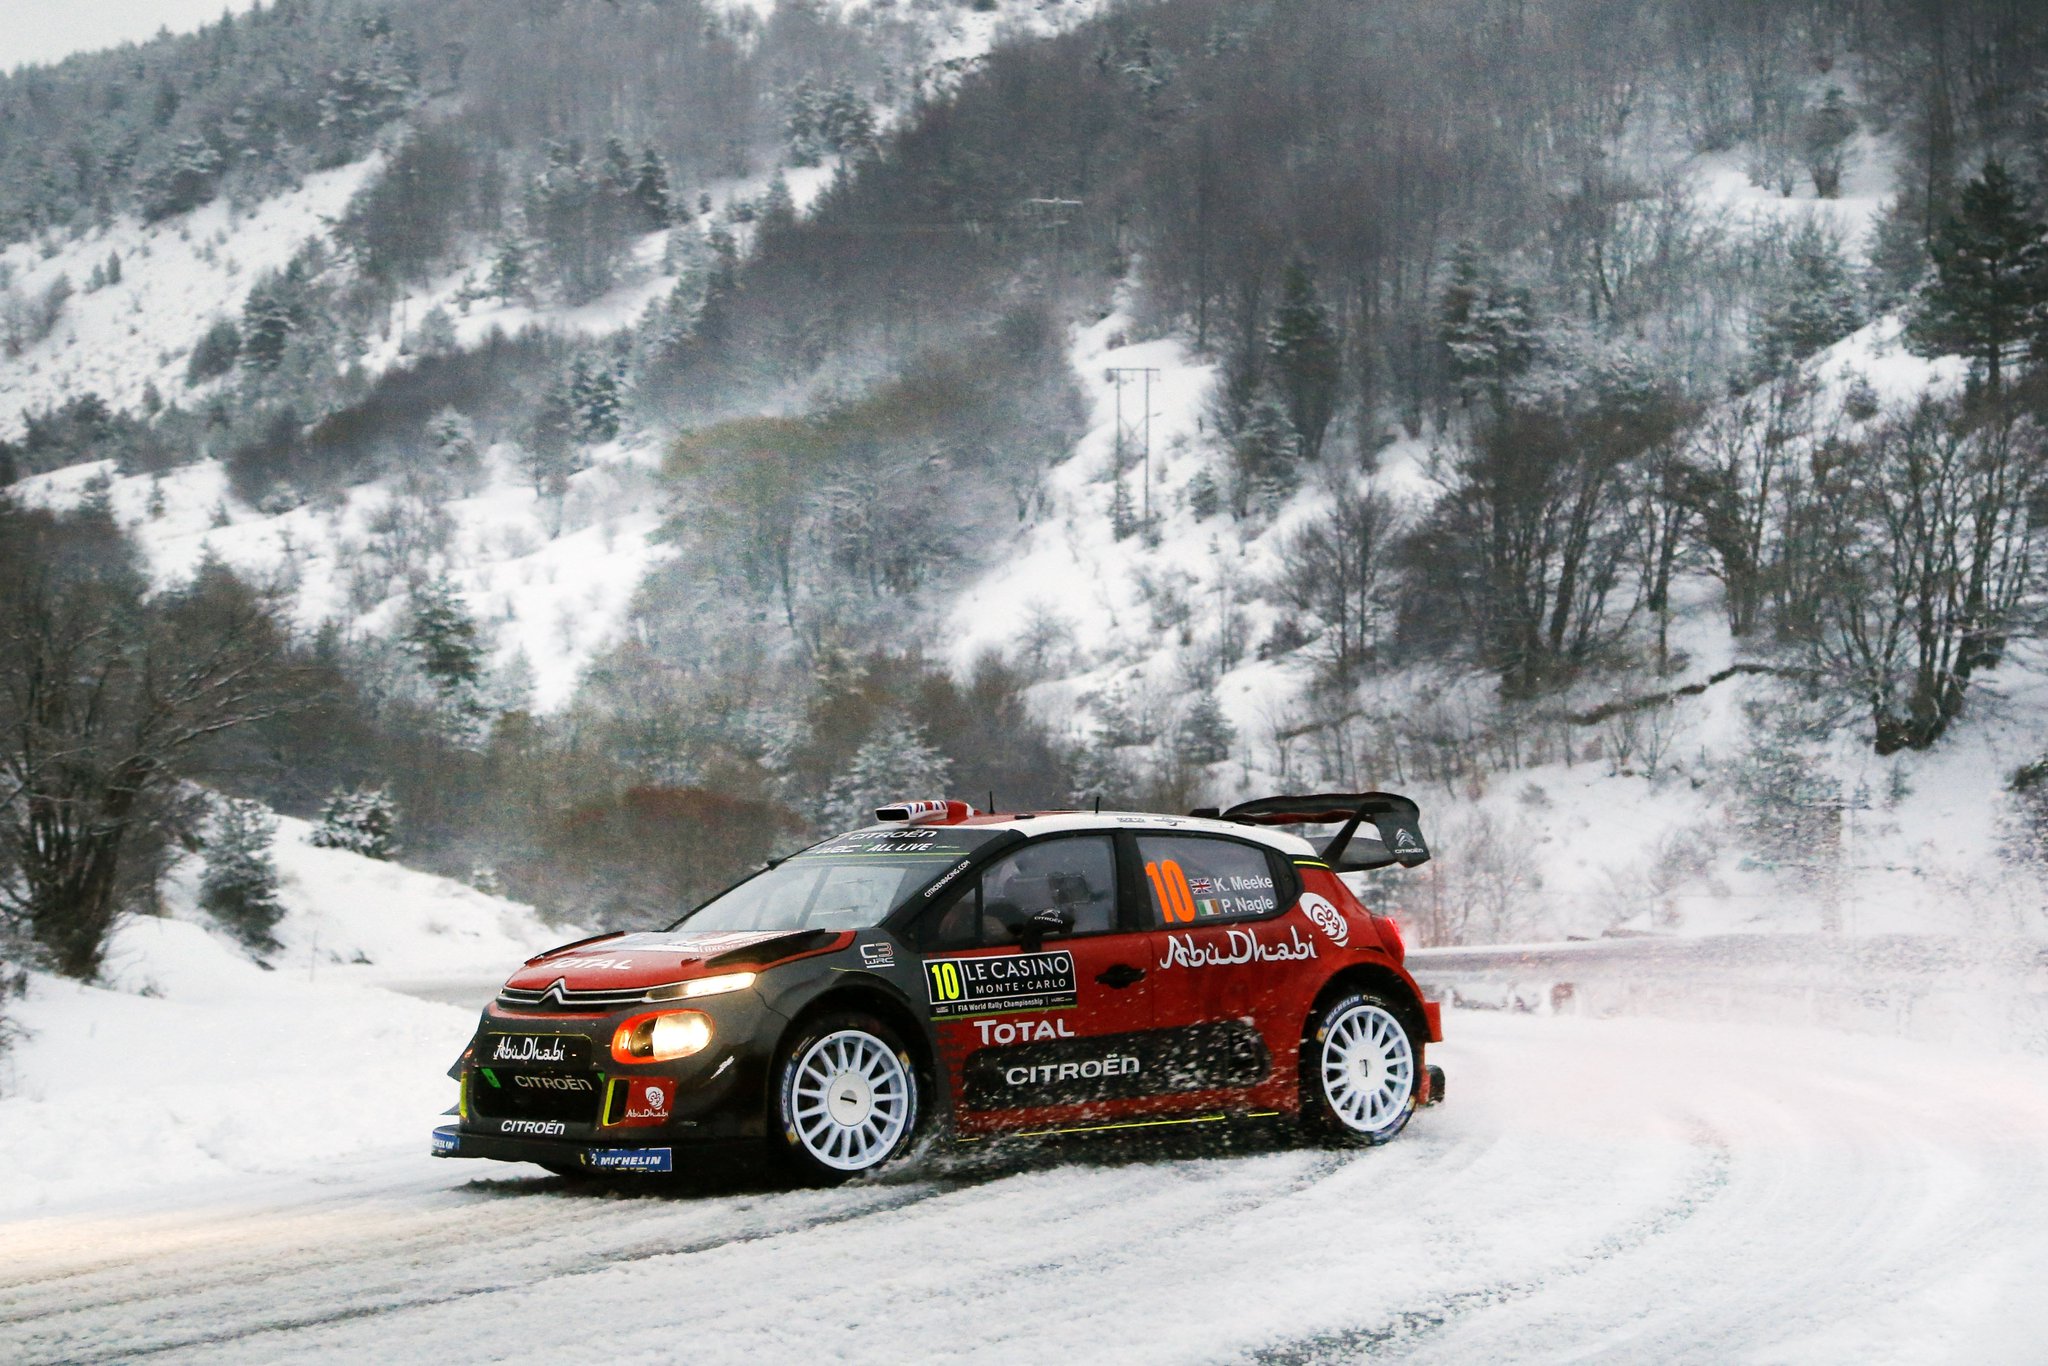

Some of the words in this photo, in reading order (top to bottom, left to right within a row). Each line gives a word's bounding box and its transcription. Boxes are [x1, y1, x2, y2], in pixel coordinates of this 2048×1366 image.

[866, 843, 894, 853] ALL
[895, 842, 933, 852] LIVE
[1145, 859, 1196, 924] 10
[1213, 879, 1230, 893] K.
[1231, 874, 1273, 891] Meeke
[1222, 900, 1235, 914] P.
[1237, 895, 1274, 914] Nagle
[859, 942, 894, 959] C3
[864, 956, 895, 965] WRC
[965, 963, 988, 982] LE
[991, 956, 1070, 979] CASINO
[931, 962, 960, 1001] 10
[957, 1003, 969, 1012] FIA
[969, 1001, 987, 1011] World
[987, 999, 1003, 1010] Rally
[1003, 997, 1044, 1009] Championship
[973, 1018, 1075, 1046] TOTAL
[599, 1155, 662, 1166] MICHELIN
